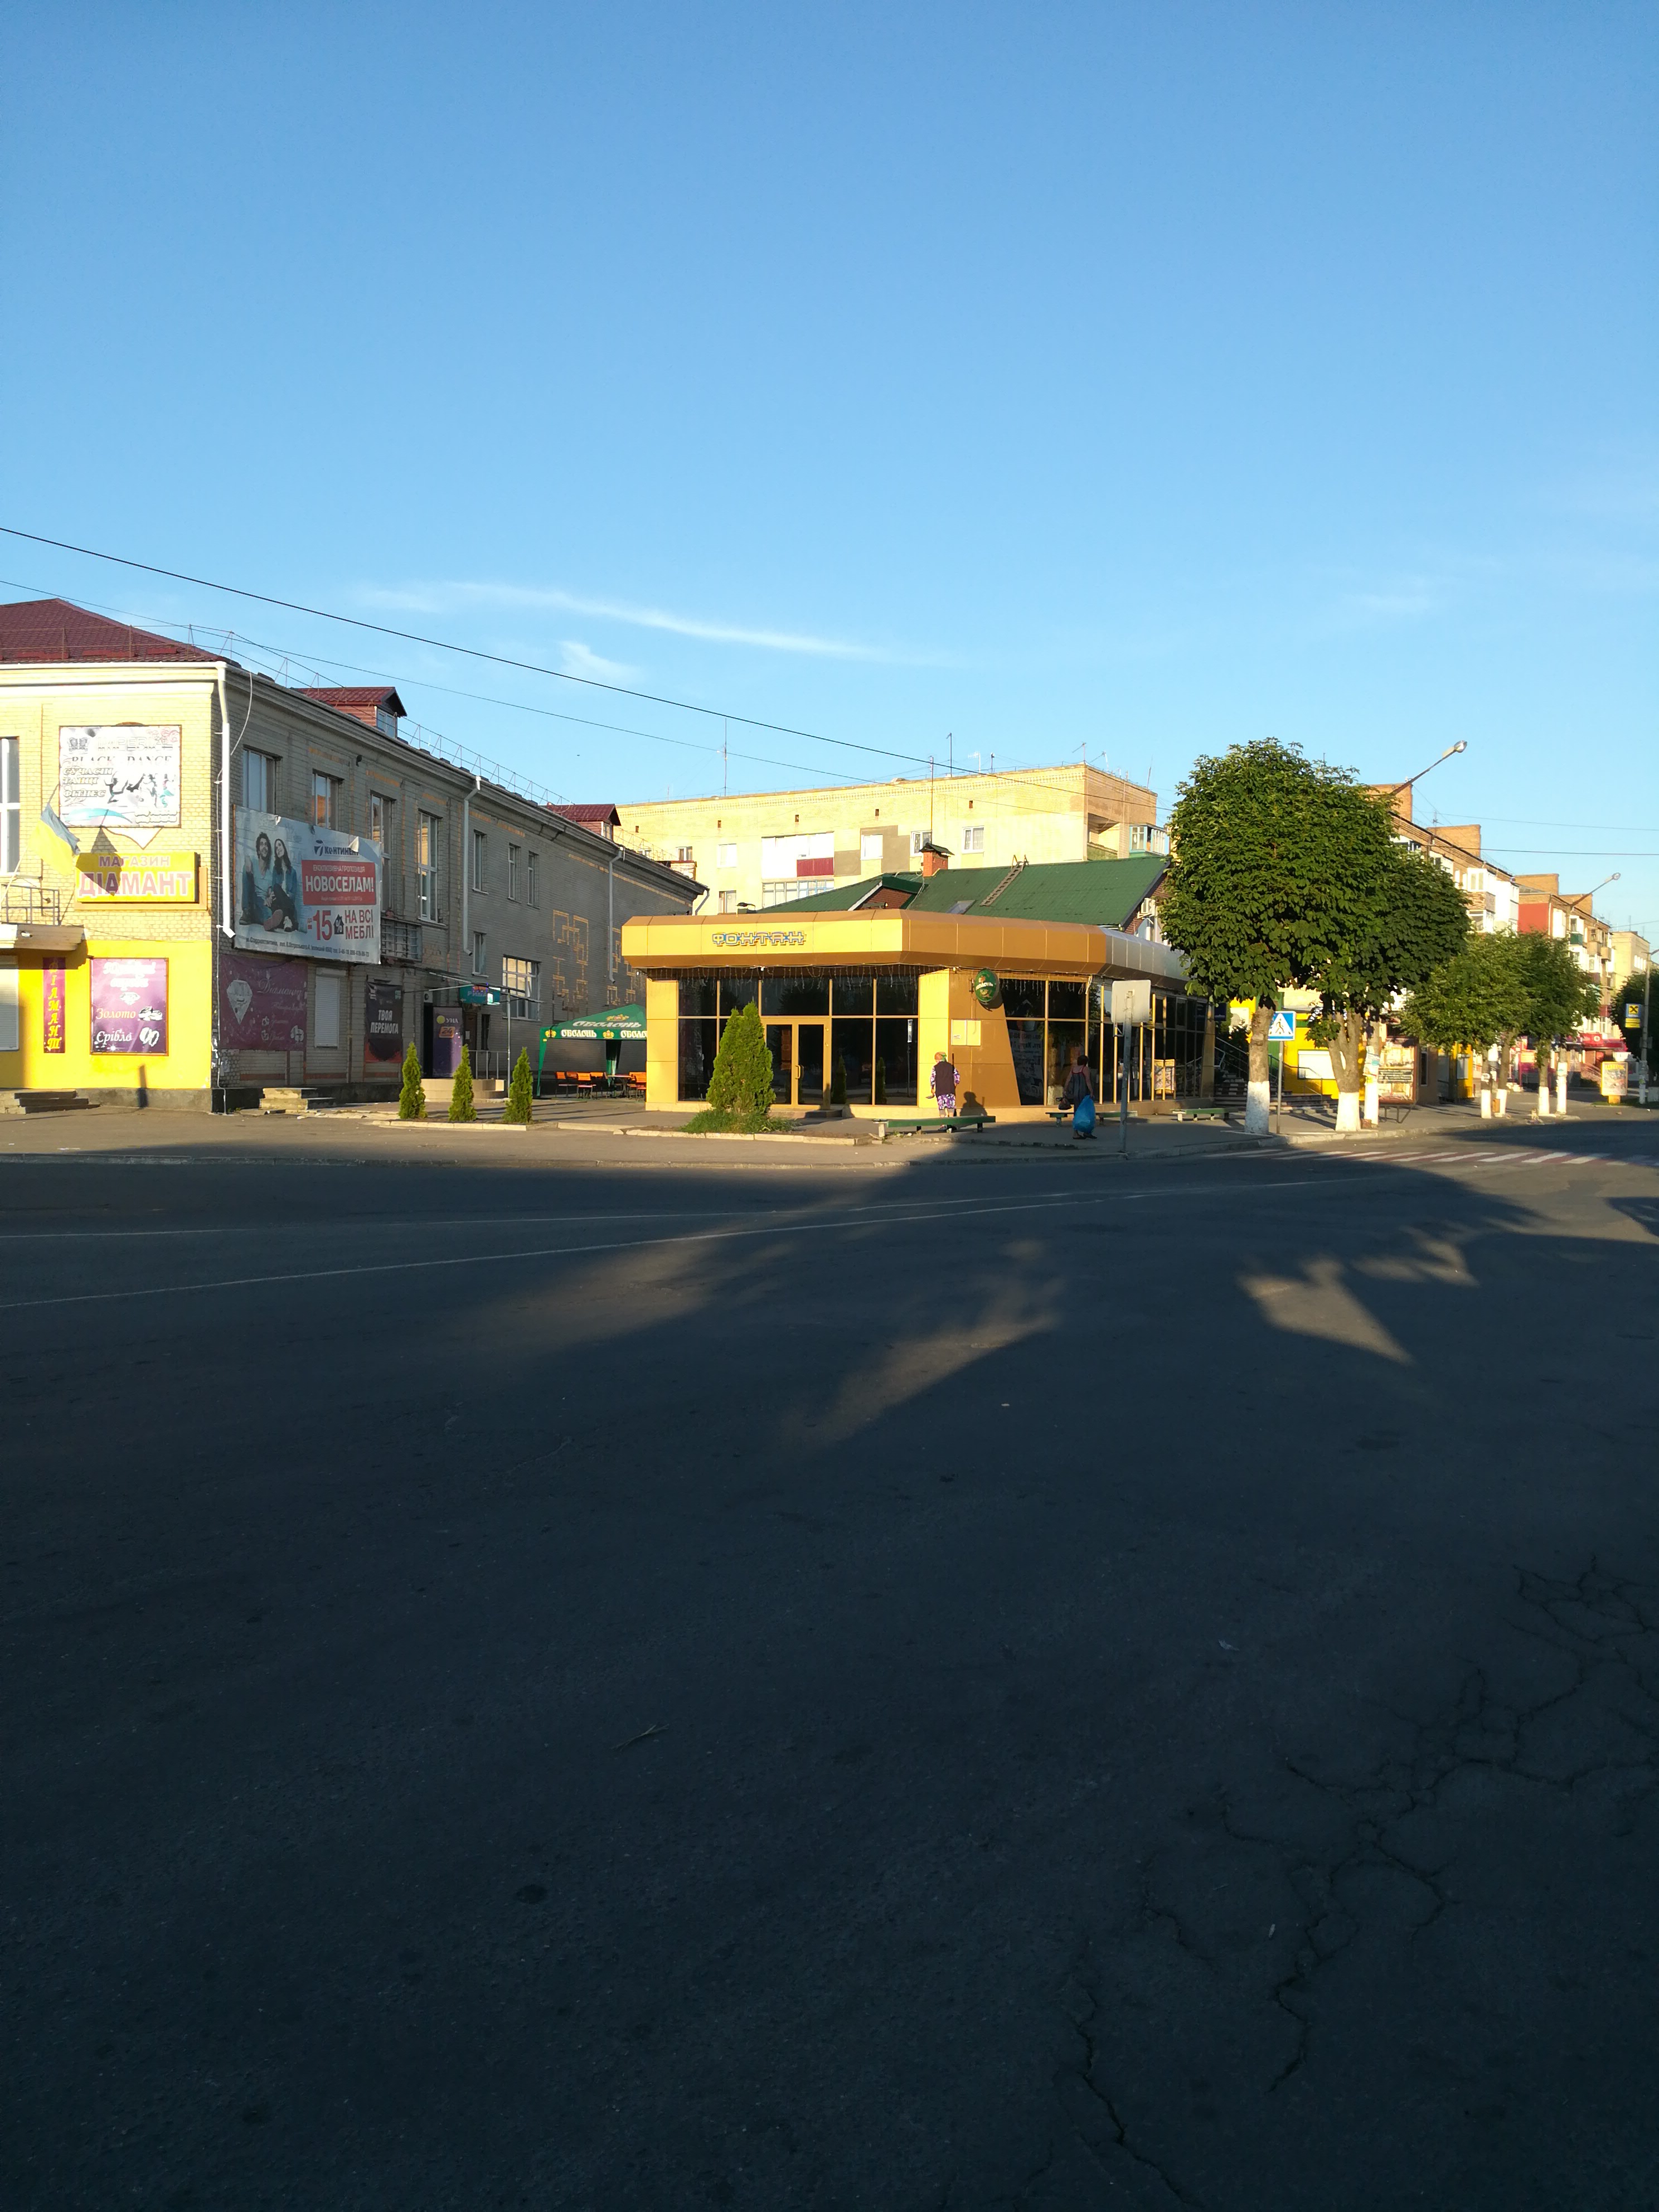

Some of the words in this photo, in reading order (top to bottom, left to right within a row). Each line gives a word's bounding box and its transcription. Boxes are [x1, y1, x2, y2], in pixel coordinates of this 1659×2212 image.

[63, 789, 106, 798] ФІТНЕС
[99, 856, 170, 867] МАГАЗИН
[79, 872, 191, 897] ДІАМАНТ
[305, 875, 374, 892] НОВОСЕЛАМ!
[345, 909, 357, 924] НА
[359, 909, 373, 923] ВСІ
[345, 925, 374, 940] МЕБЛІ
[712, 931, 806, 947] ФОНТАН
[95, 1008, 136, 1020] Золото
[378, 1010, 393, 1021] ТВОЯ
[370, 1022, 399, 1034] ПЕРЕМОГА
[561, 1029, 597, 1038] ОБОЛОНЬ
[620, 1030, 648, 1038] ОБОЛО
[96, 1029, 133, 1045] Срібло
